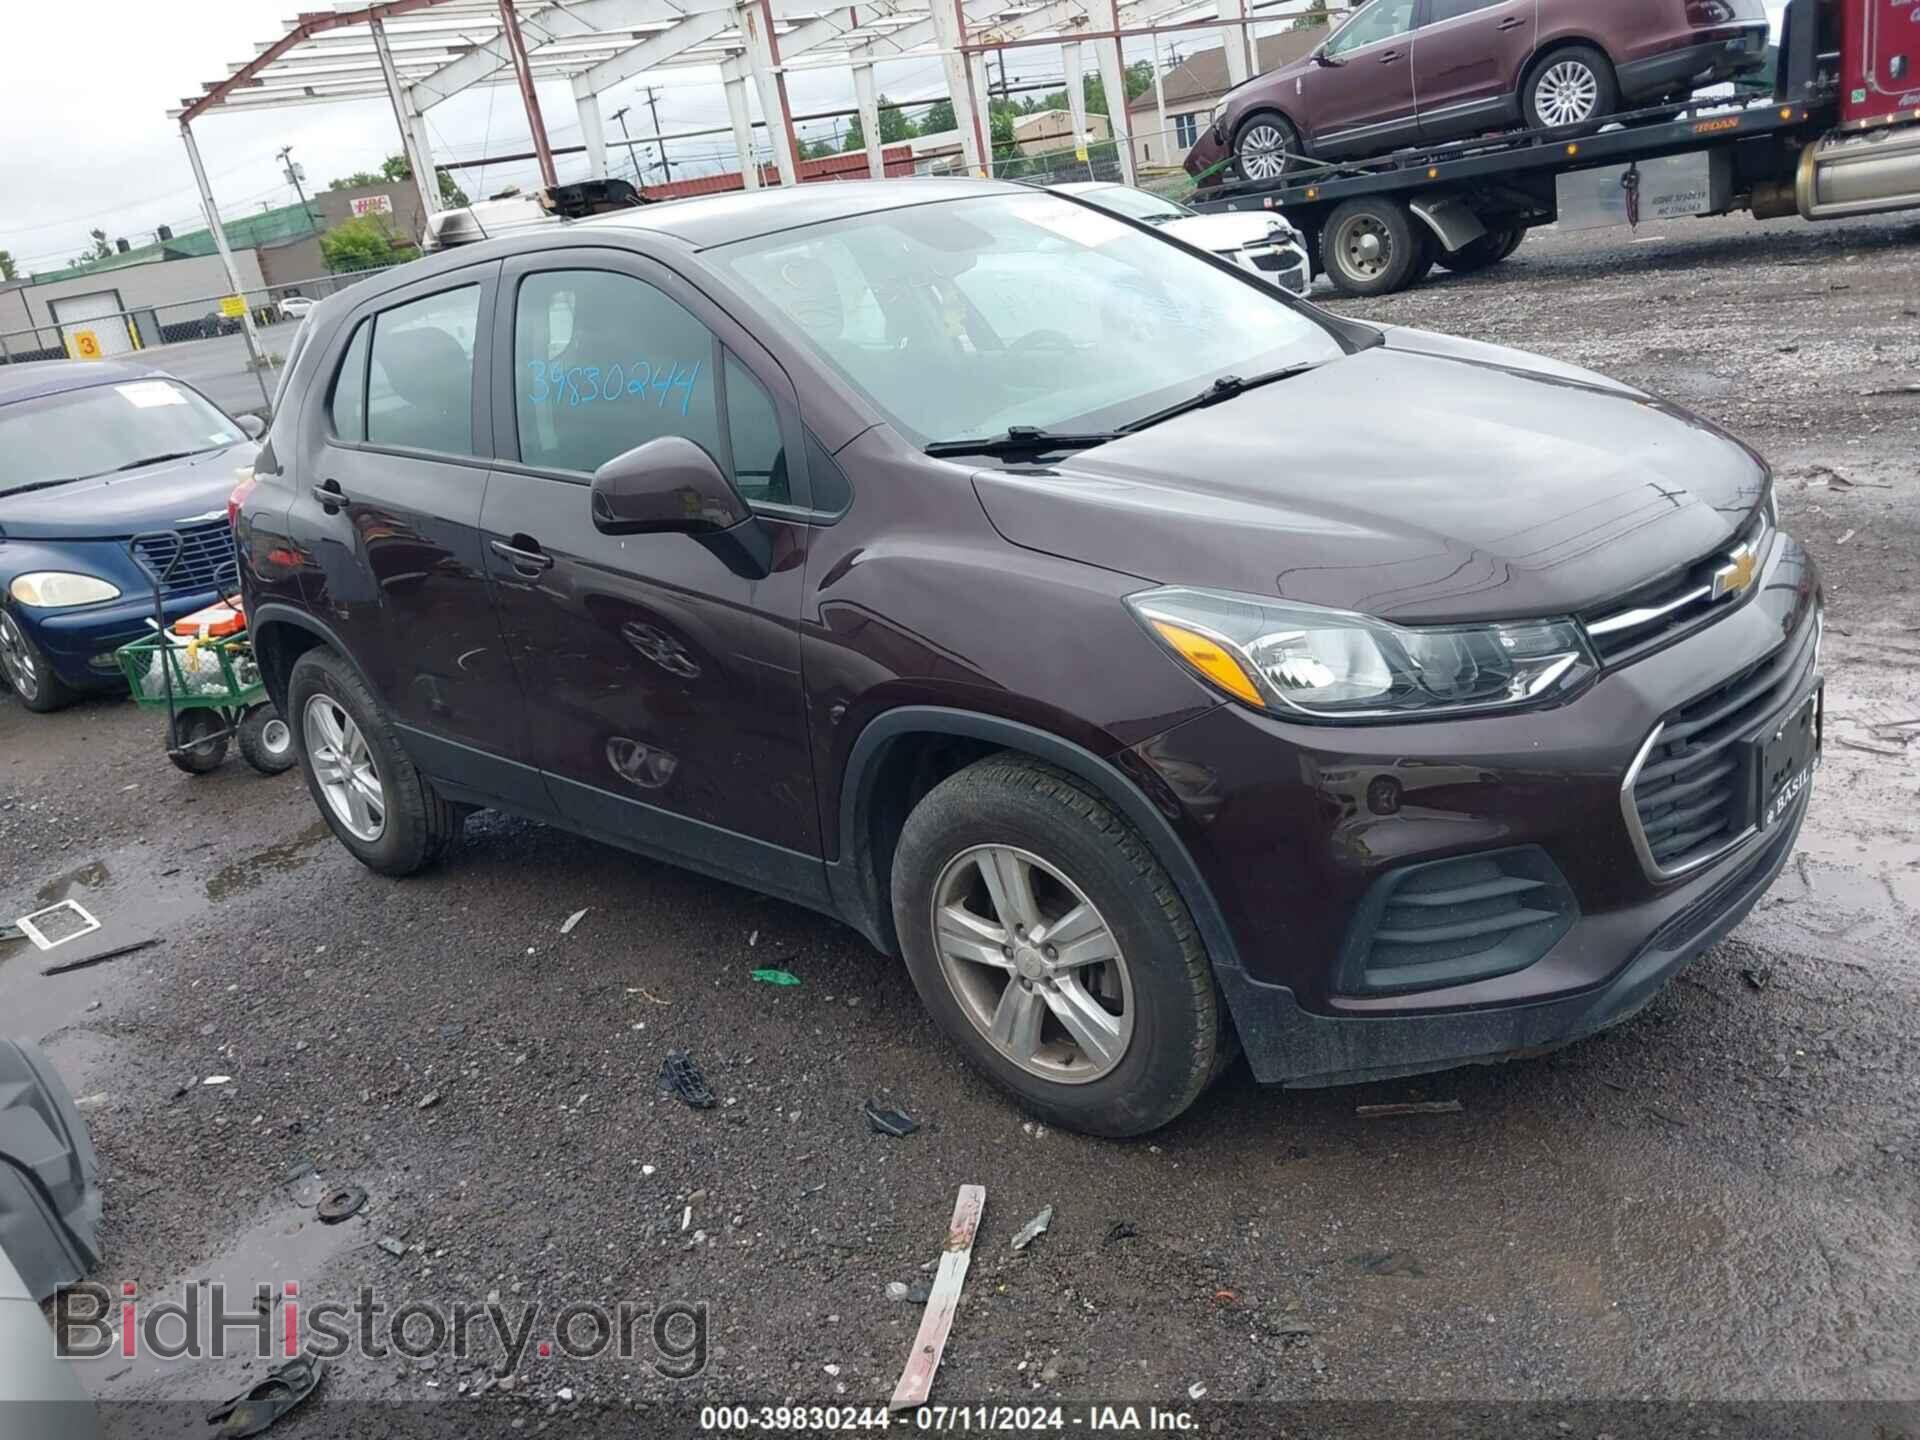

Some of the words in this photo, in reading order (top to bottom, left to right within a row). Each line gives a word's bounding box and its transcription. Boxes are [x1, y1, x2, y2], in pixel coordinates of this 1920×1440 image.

[80, 336, 95, 354] 3
[527, 359, 703, 417] 39830244
[1776, 767, 1809, 815] BASIL
